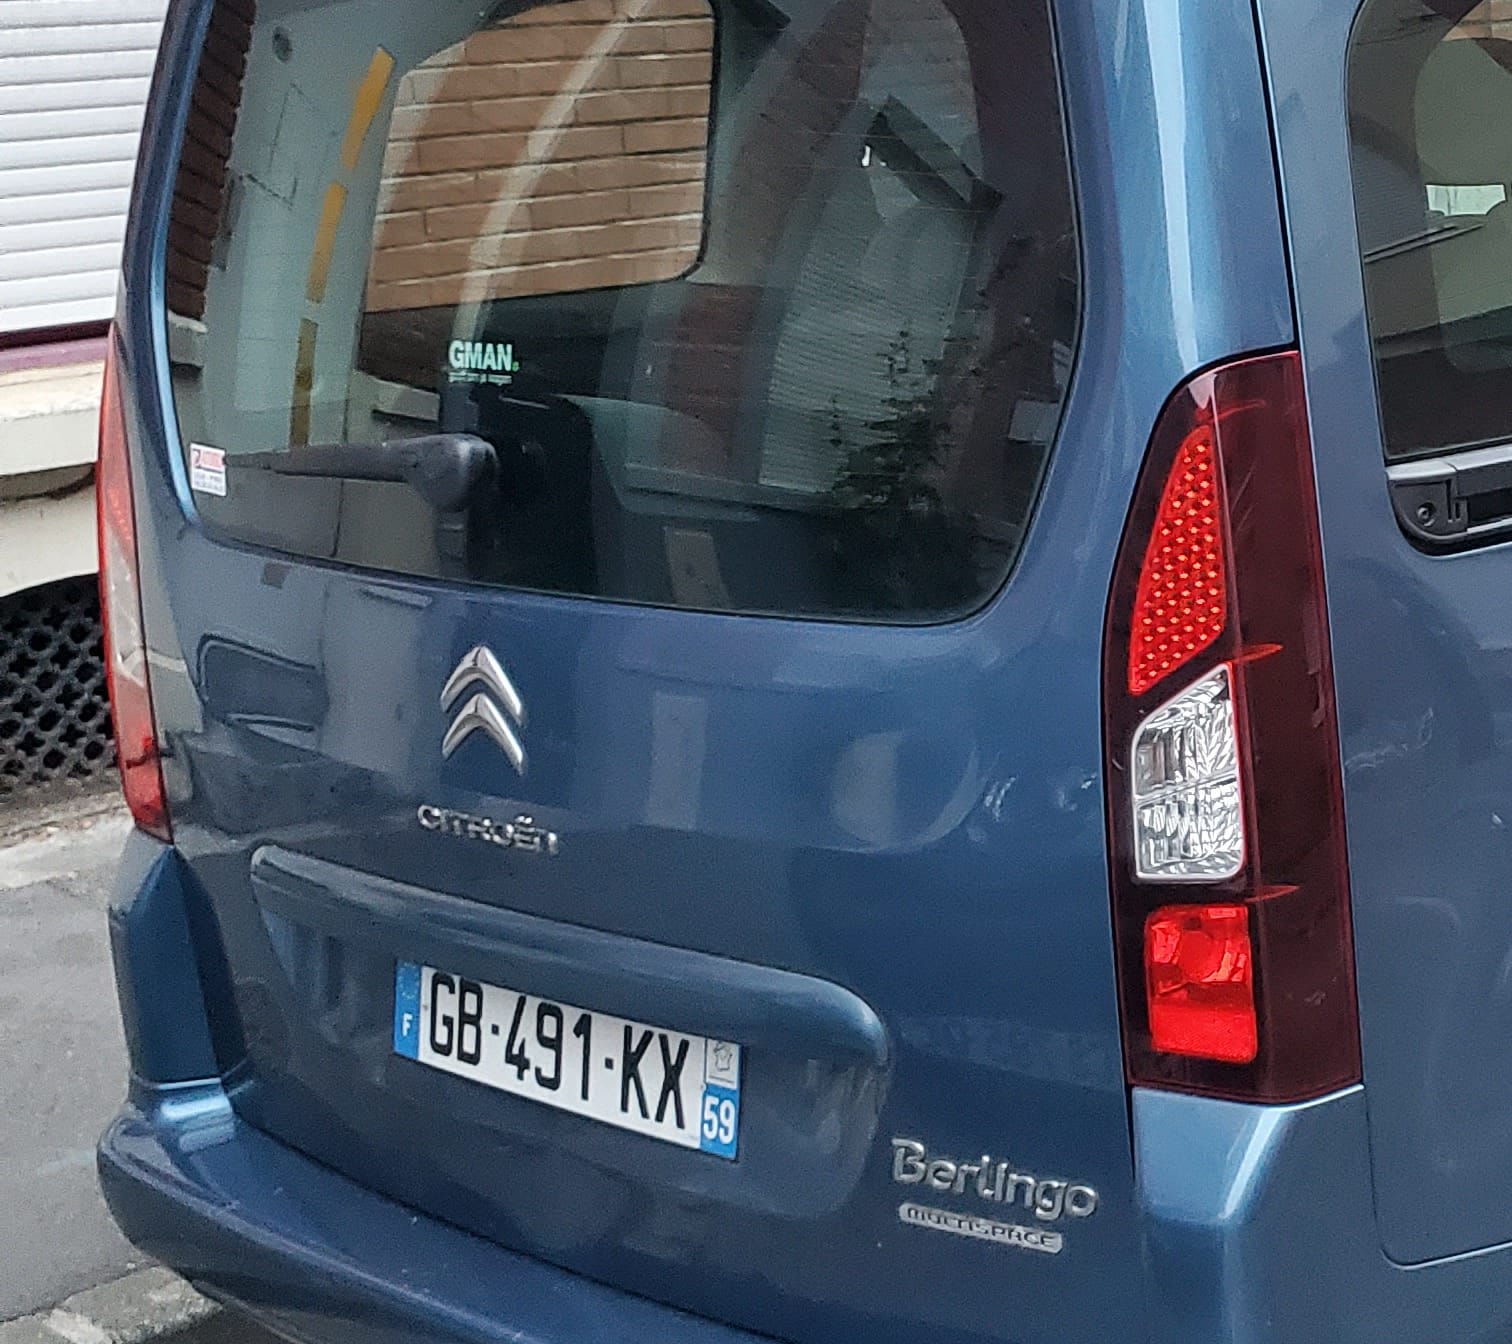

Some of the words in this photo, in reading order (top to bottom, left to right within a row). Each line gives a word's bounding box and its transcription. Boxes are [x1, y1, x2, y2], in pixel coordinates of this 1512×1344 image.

[400, 1012, 413, 1038] F
[429, 971, 690, 1130] GB-491-KX
[703, 1094, 736, 1145] 59
[891, 1137, 1098, 1221] Berlingo
